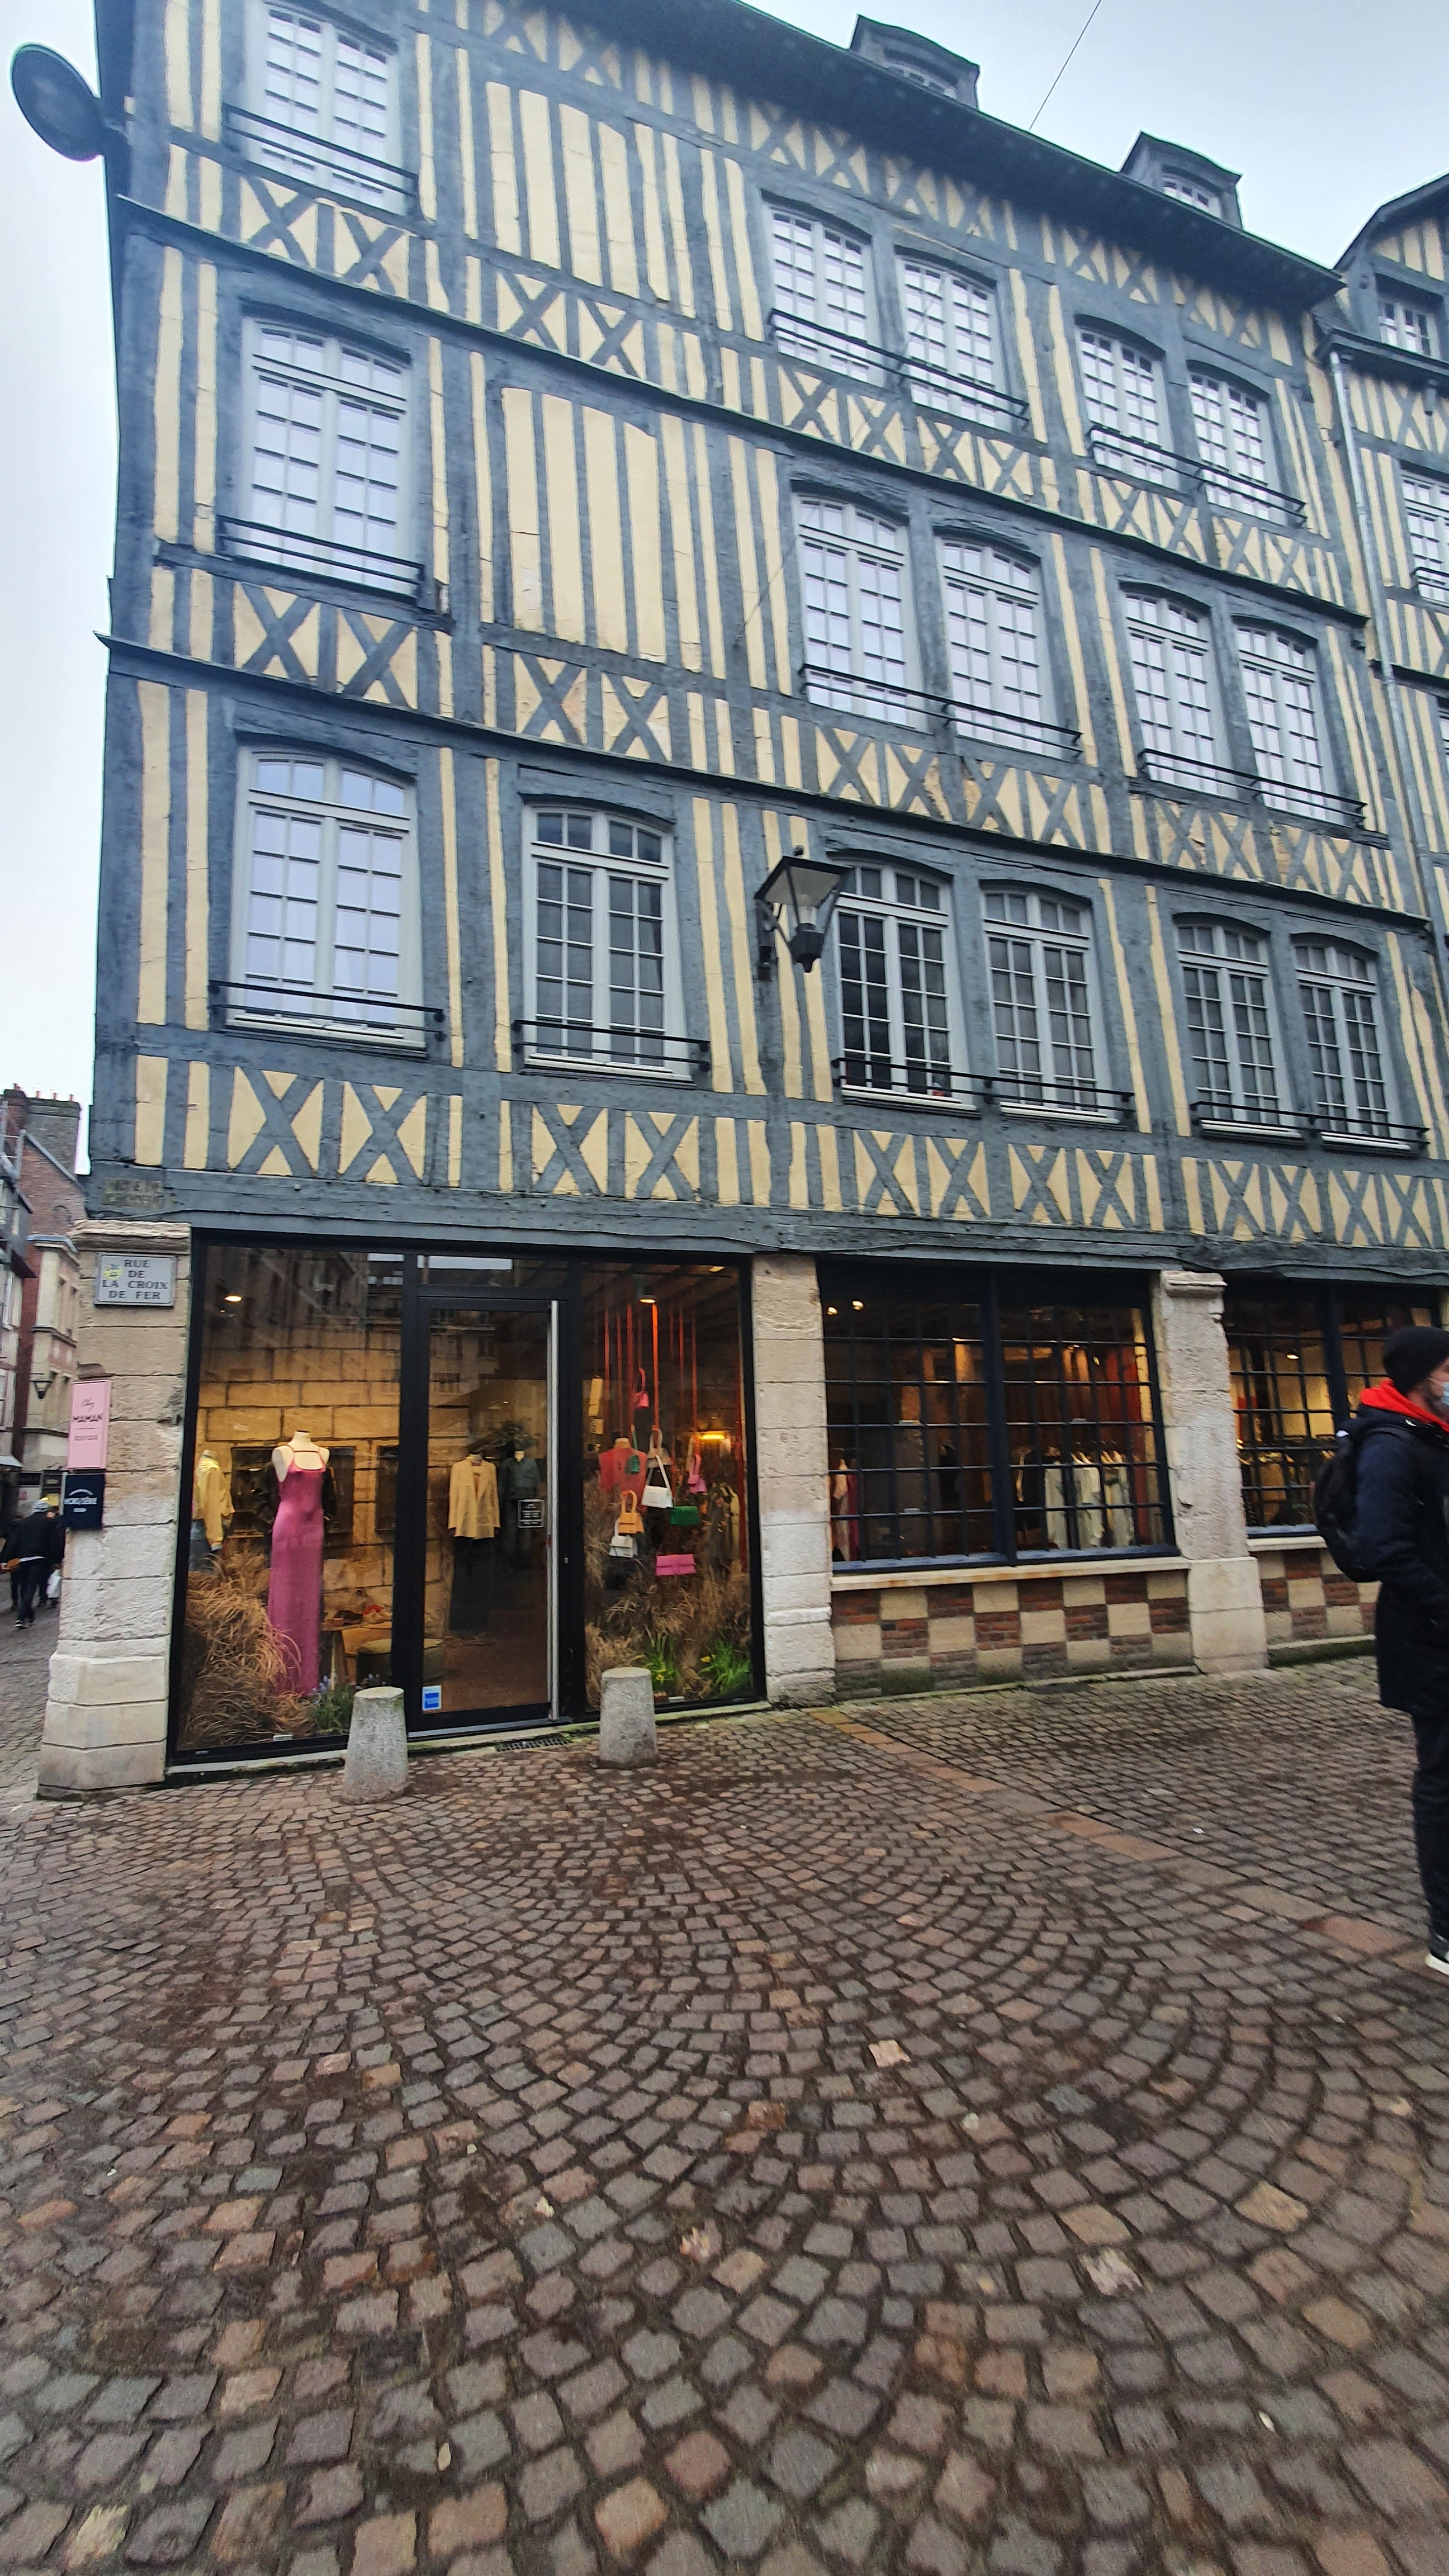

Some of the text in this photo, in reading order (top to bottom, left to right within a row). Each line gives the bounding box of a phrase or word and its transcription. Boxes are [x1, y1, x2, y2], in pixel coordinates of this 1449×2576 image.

[124, 1259, 150, 1268] RUE
[102, 1280, 168, 1289] LA CROIX
[108, 1290, 127, 1299] DE
